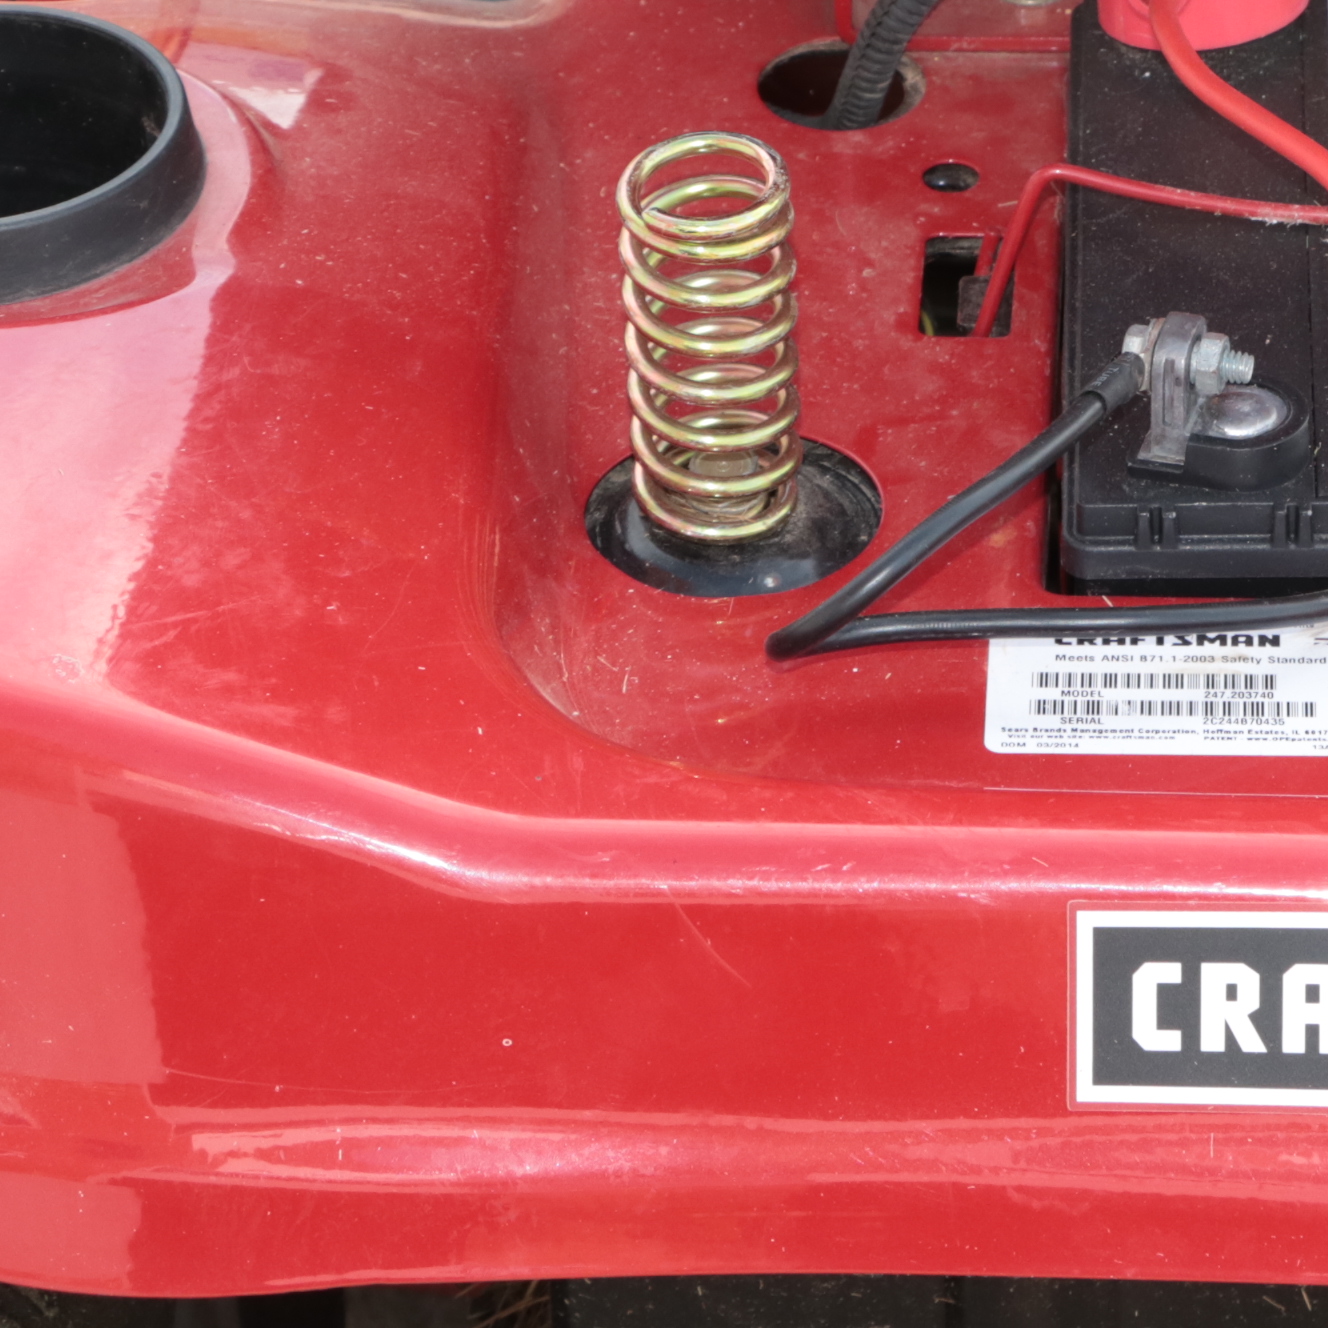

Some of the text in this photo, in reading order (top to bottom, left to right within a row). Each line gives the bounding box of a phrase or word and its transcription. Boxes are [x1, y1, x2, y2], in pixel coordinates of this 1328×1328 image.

[1055, 654, 1095, 662] Meets
[1140, 655, 1215, 663] B71.1-2003
[1221, 656, 1261, 665] Safety
[1268, 656, 1327, 664] Standard
[1061, 690, 1104, 698] MODEL
[1204, 691, 1274, 699] 247.203740
[1060, 717, 1104, 725] SERIAL
